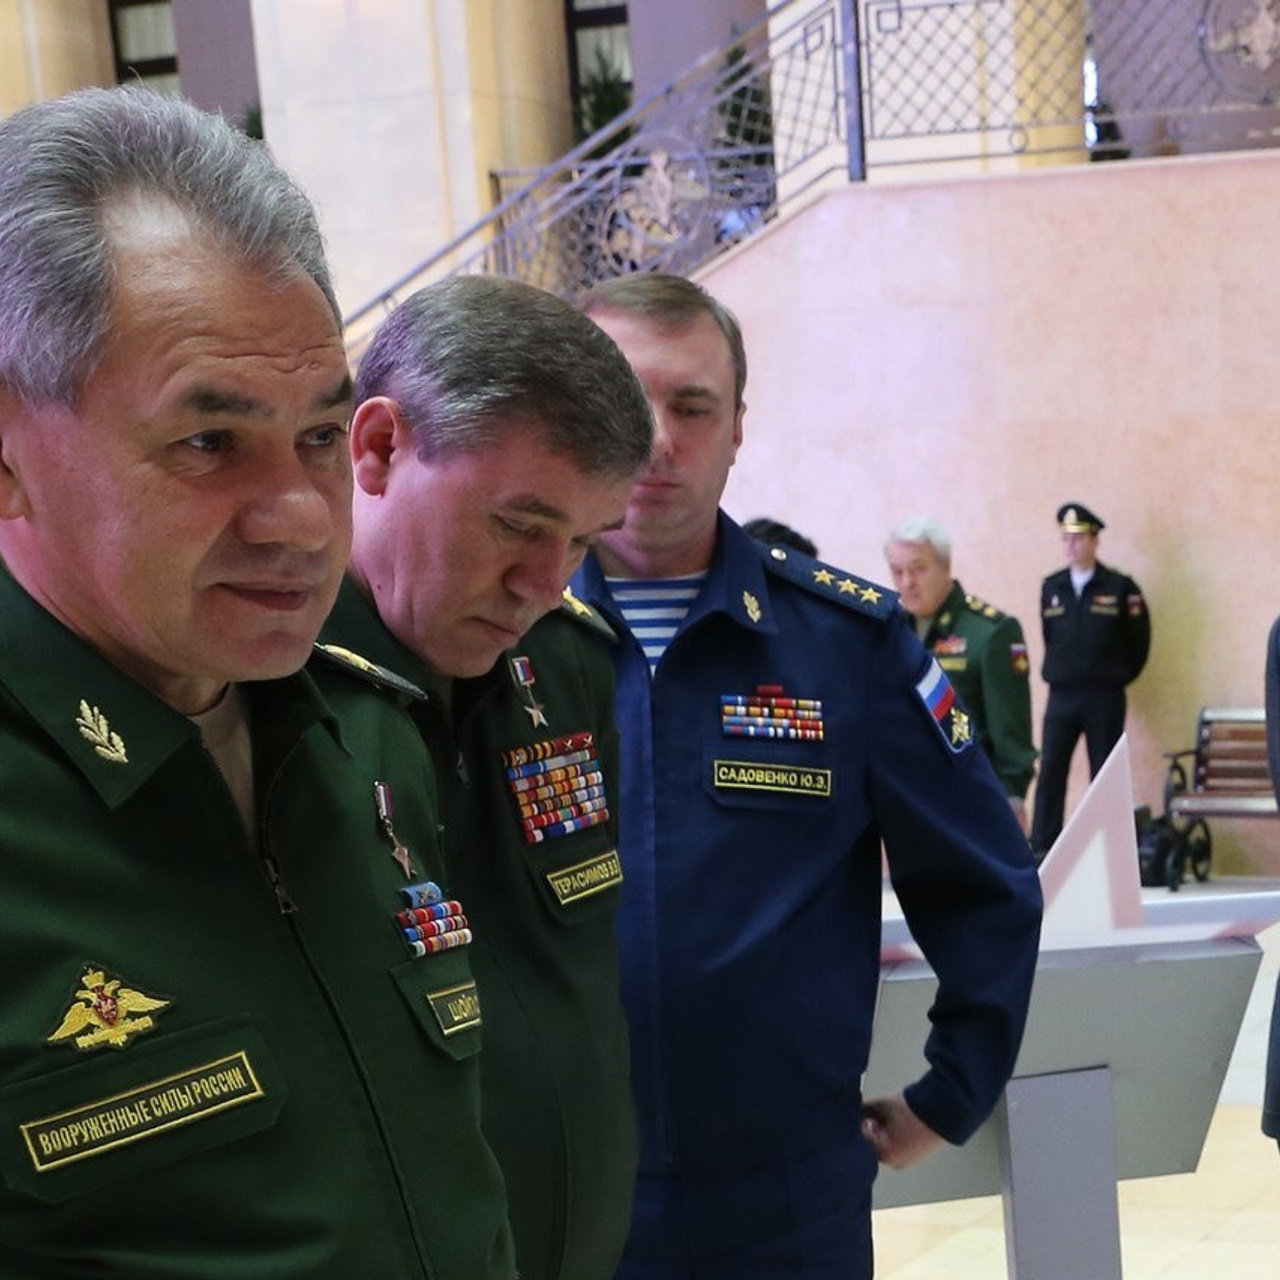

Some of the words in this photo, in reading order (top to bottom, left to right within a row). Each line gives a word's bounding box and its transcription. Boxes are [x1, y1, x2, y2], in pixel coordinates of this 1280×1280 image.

[718, 766, 798, 786] САДОВЕНКО
[38, 1100, 153, 1155] ВООРУЖЕННЫЕ
[150, 1084, 196, 1117] СИЛЫ
[190, 1067, 248, 1104] РОССИИ
